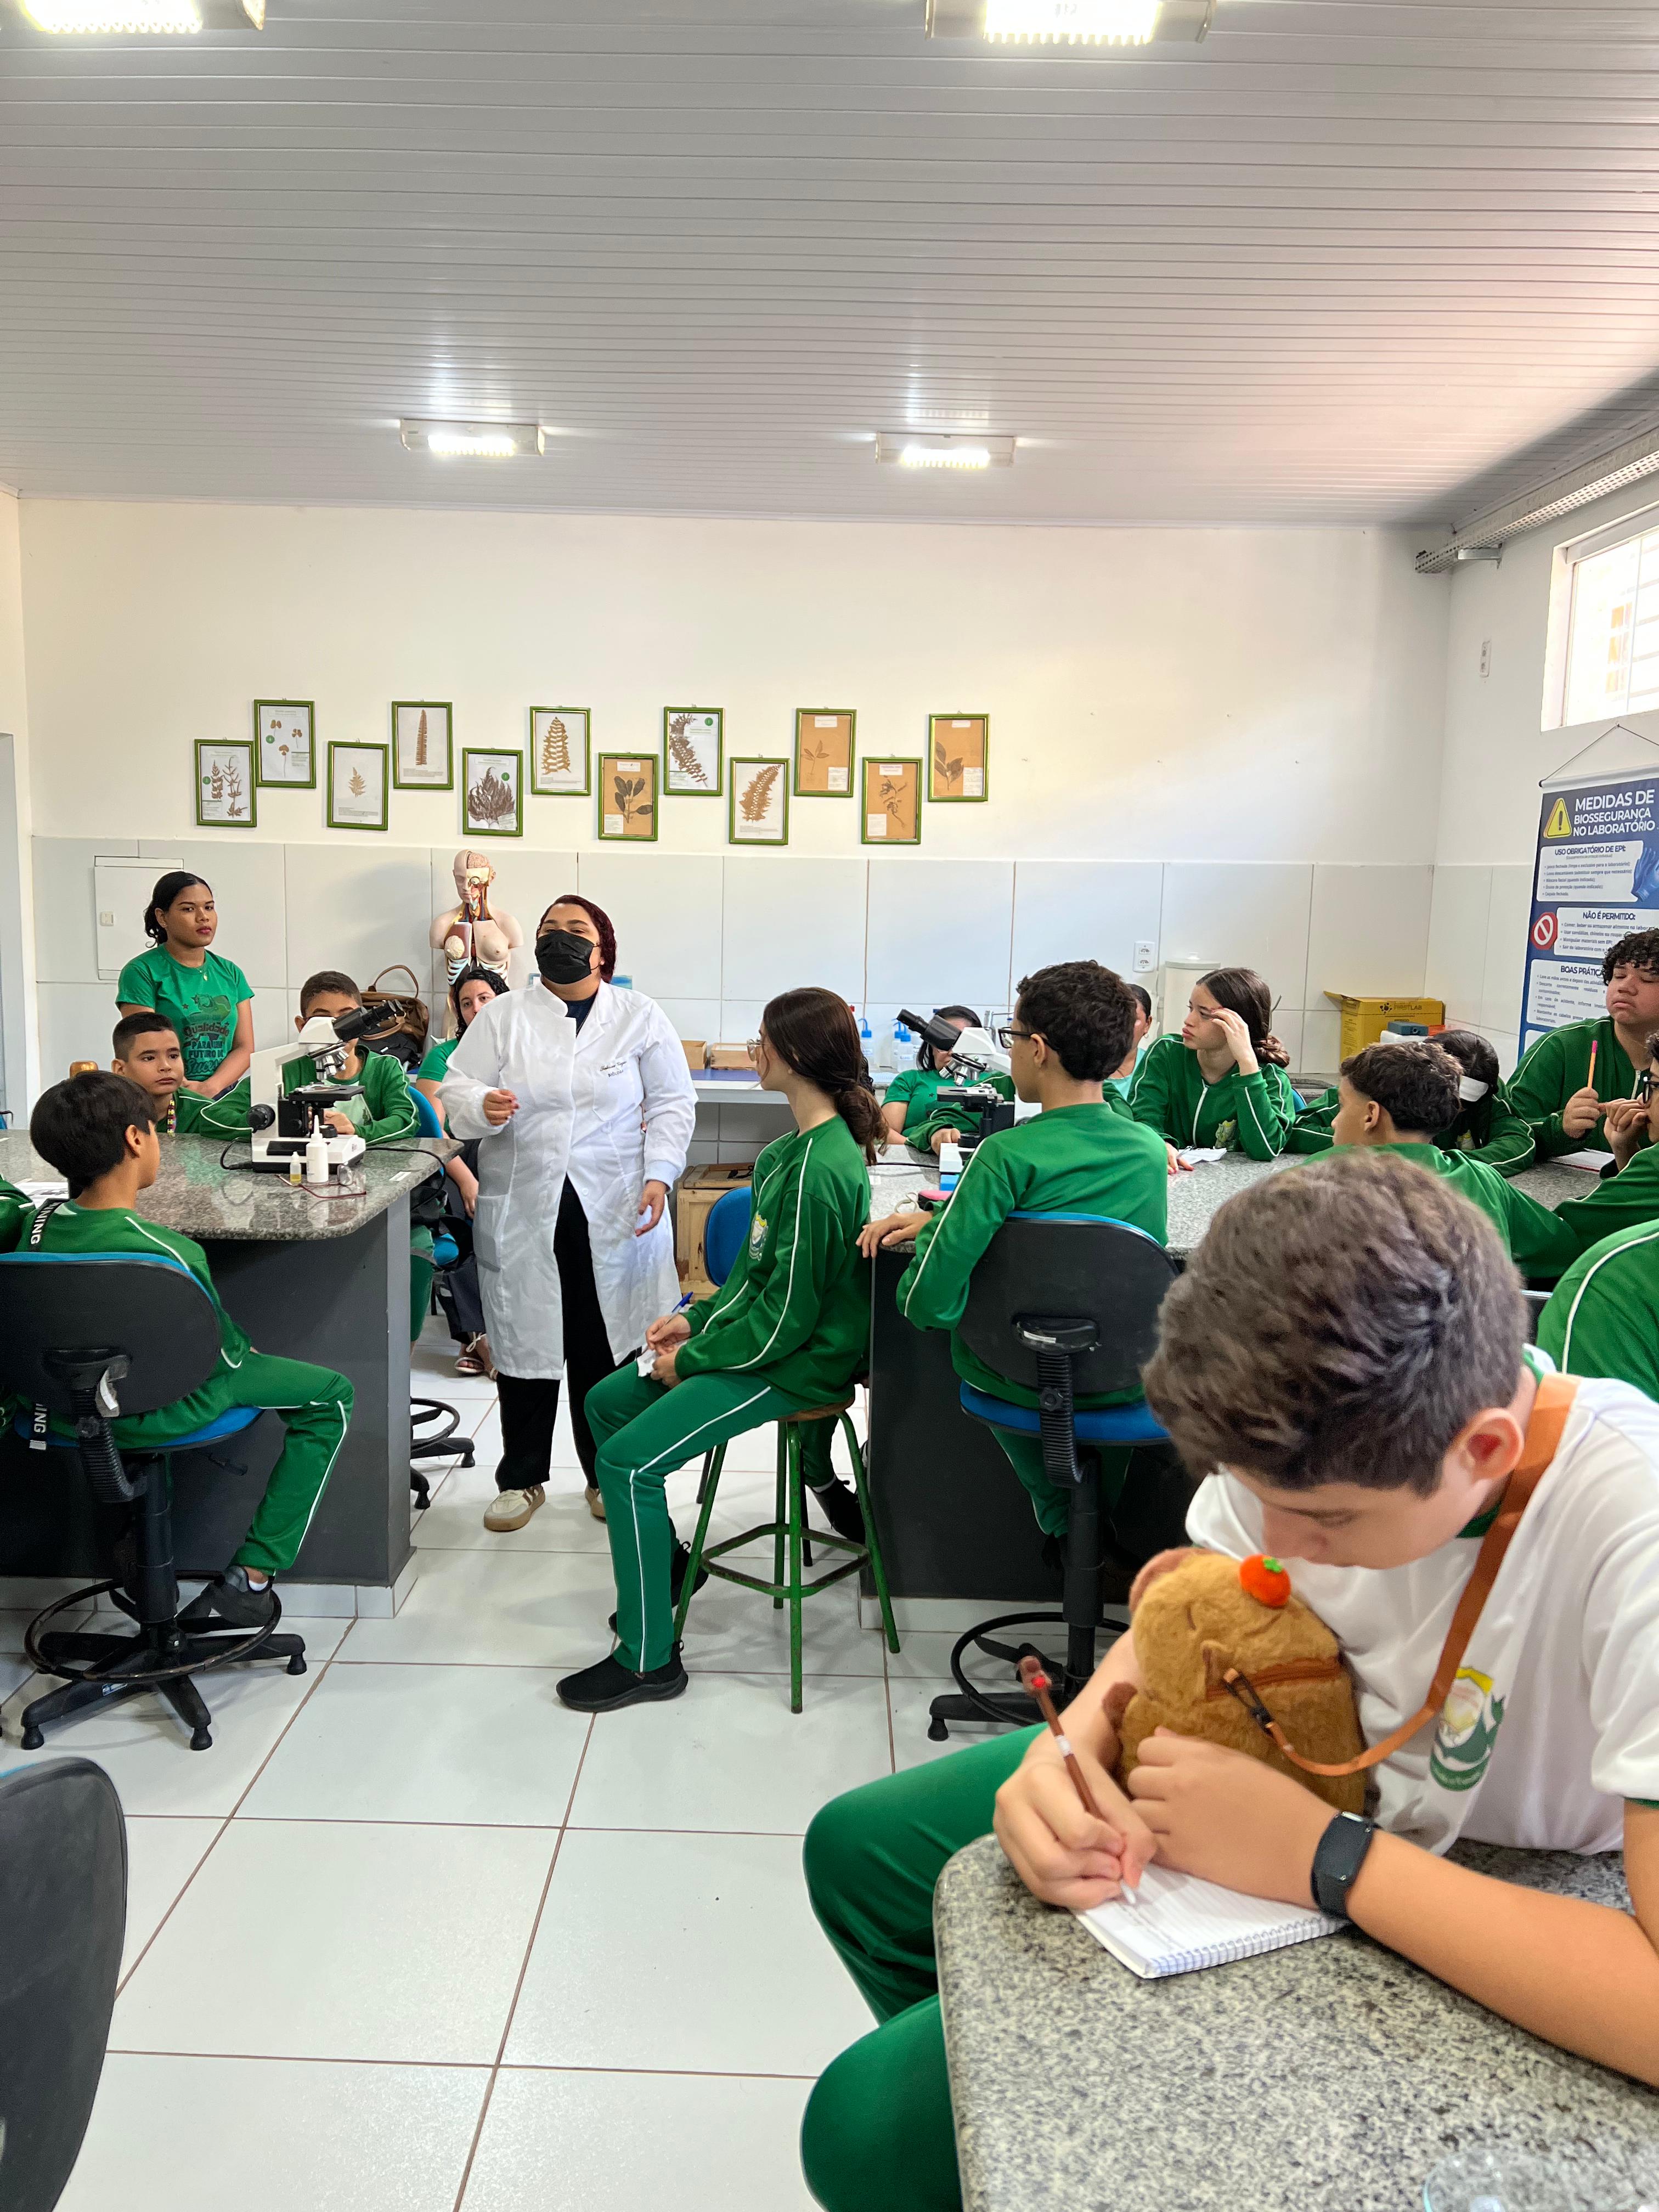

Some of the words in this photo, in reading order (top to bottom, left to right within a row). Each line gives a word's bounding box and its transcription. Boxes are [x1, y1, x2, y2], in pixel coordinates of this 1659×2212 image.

[1575, 792, 1633, 811] MEDIDAS
[1635, 789, 1655, 804] DE
[1574, 808, 1651, 825] BIOSSEGURANÇA
[1573, 826, 1587, 837] NO
[1588, 818, 1656, 836] LABORATÓRIO
[1566, 845, 1605, 855] OBRIGATÓRIO
[1583, 911, 1596, 919] NÃO
[1597, 911, 1601, 919] É
[1561, 966, 1577, 974] BOAS
[1578, 966, 1601, 976] PRÁTIC
[33, 1403, 47, 1433] ING
